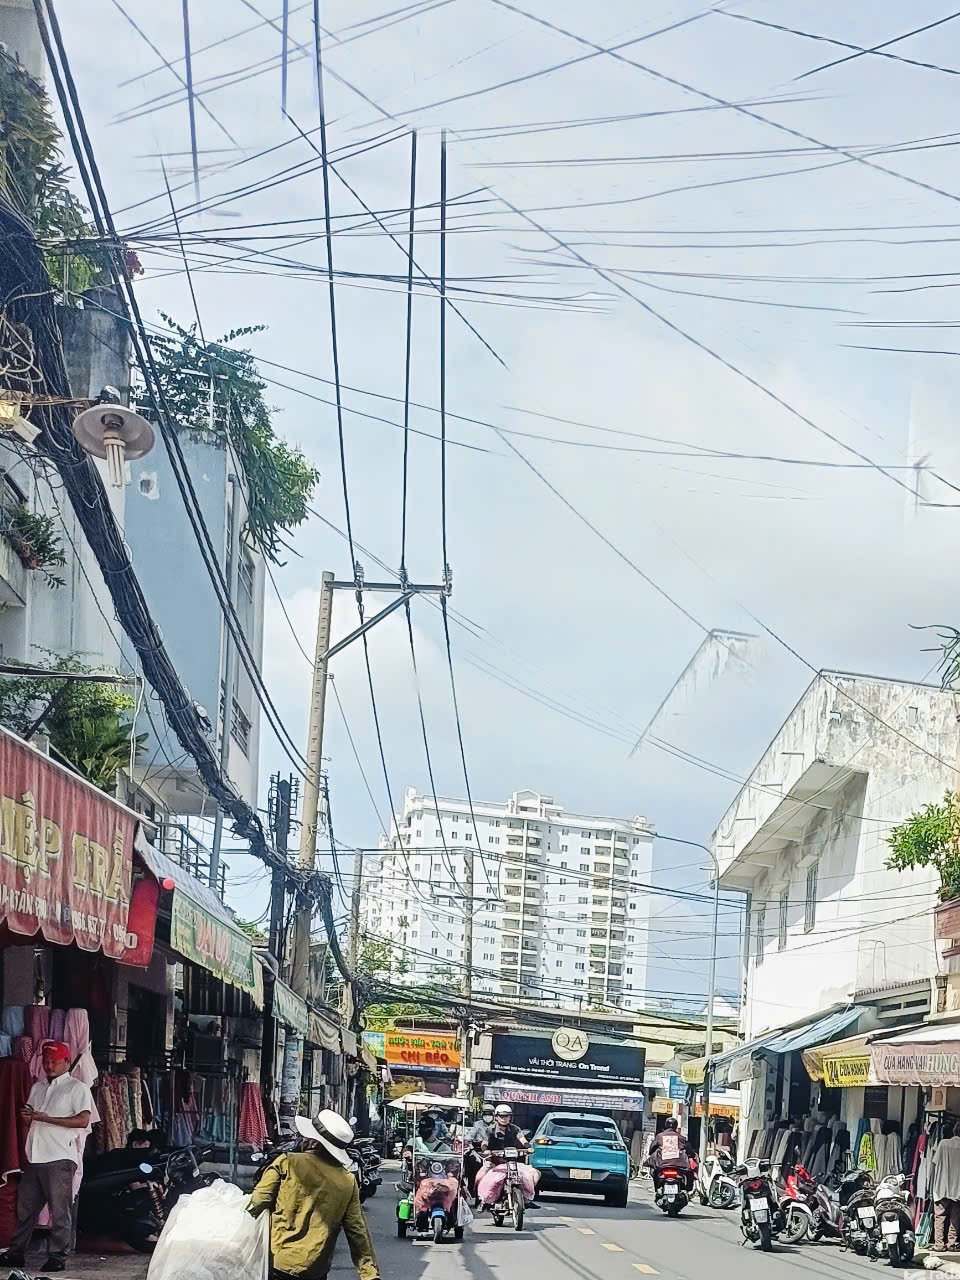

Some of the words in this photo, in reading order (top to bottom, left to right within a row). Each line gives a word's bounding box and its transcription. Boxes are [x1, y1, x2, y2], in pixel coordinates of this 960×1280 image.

[556, 1033, 584, 1052] QA
[555, 1060, 577, 1069] TRANG
[578, 1062, 589, 1070] On
[539, 1092, 562, 1104] ANH
